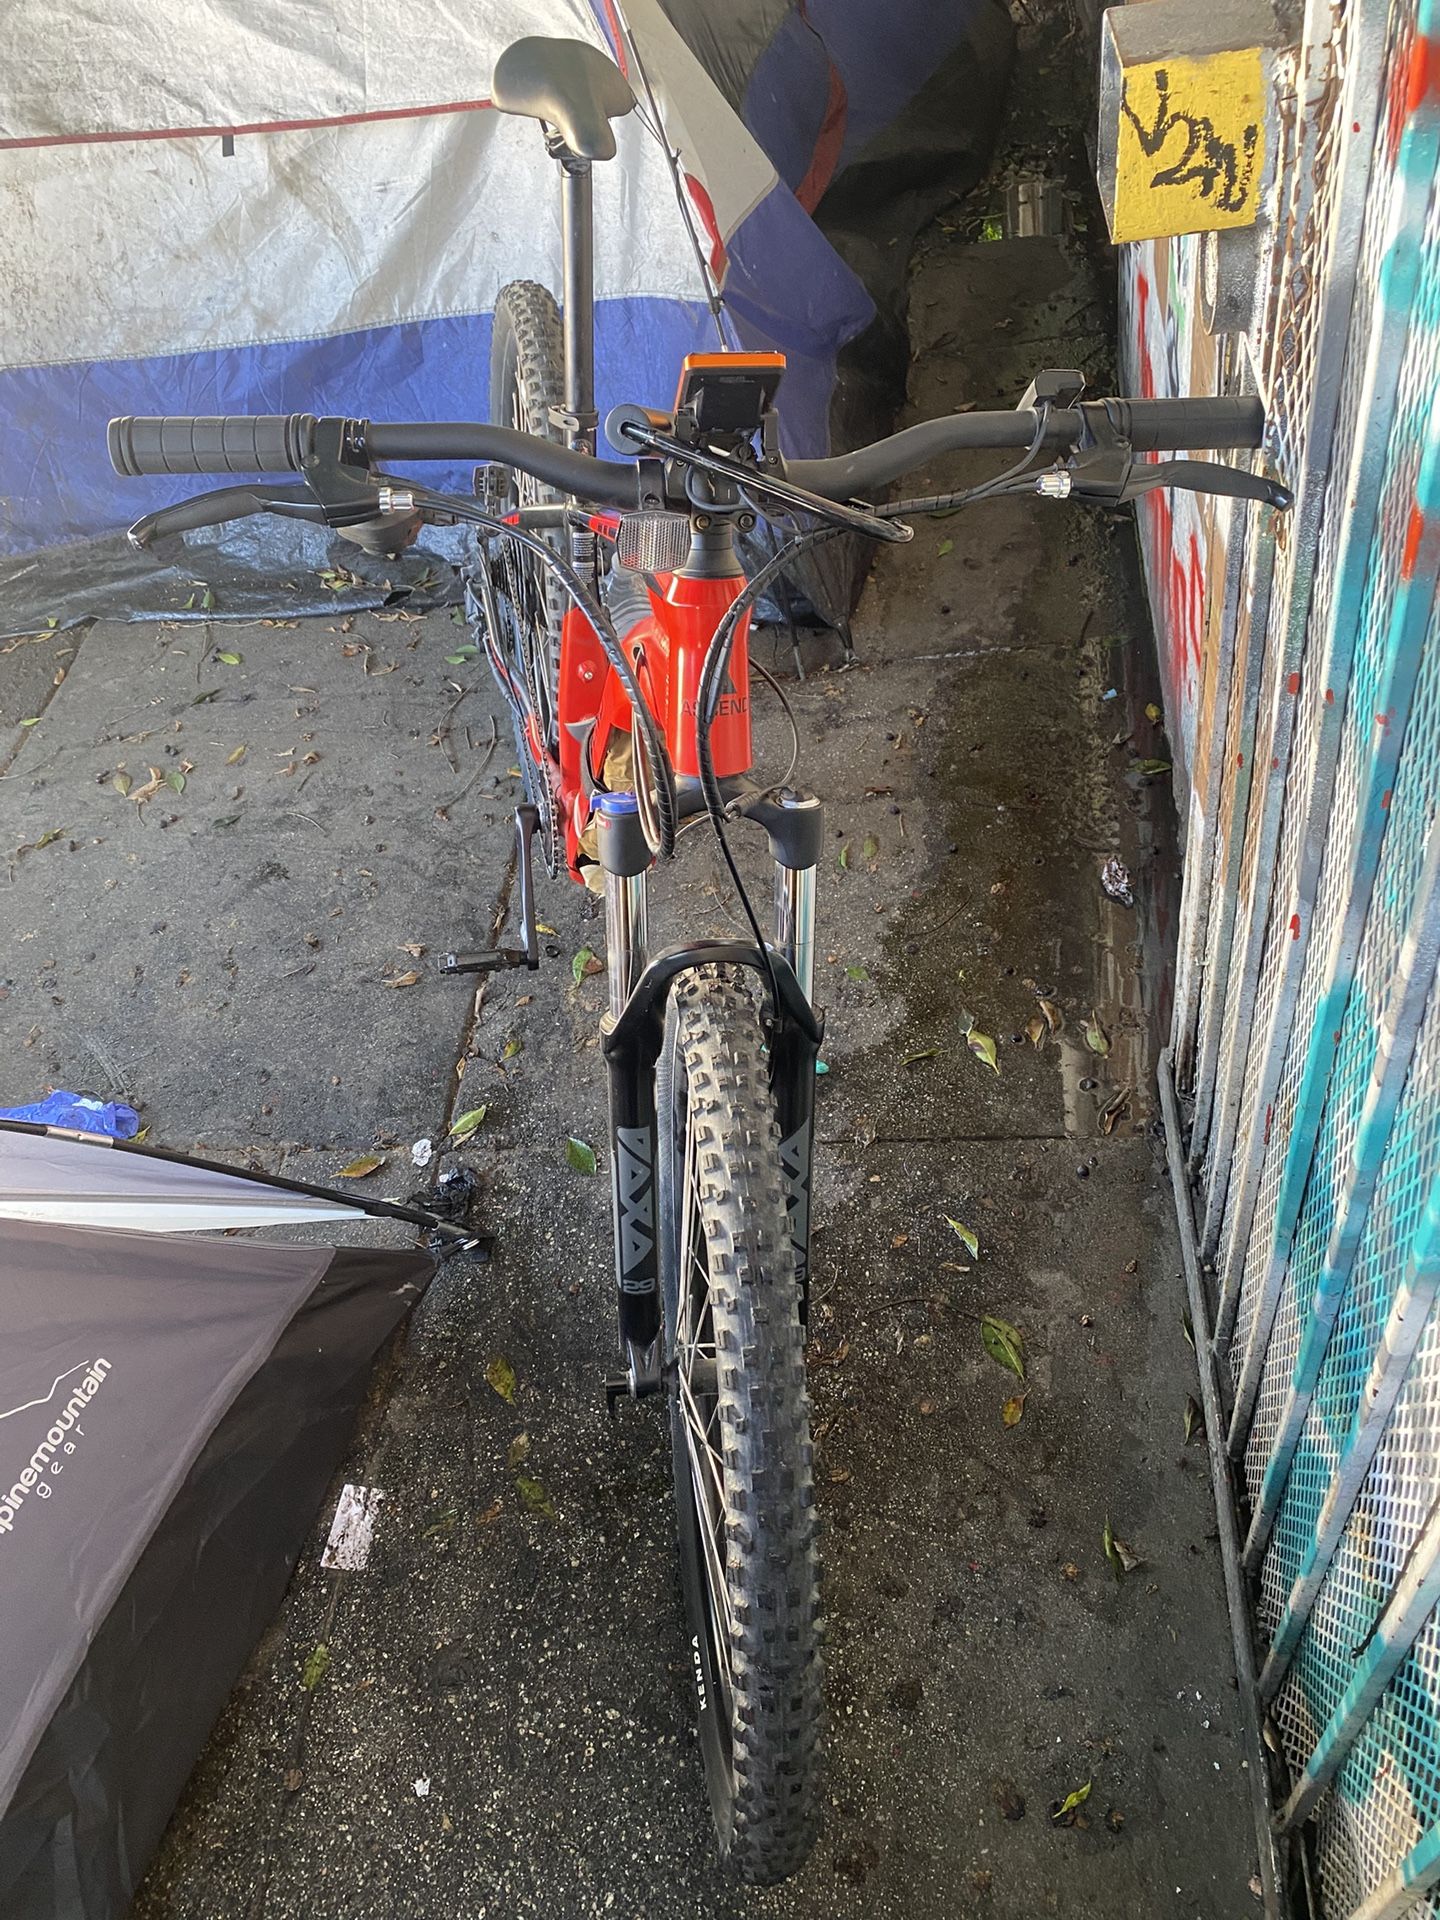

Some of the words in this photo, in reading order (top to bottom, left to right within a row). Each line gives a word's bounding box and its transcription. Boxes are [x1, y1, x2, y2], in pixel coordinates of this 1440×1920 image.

[681, 696, 748, 716] AEND
[622, 1277, 656, 1295] 29
[0, 1358, 112, 1534] pinemountain
[36, 1424, 85, 1499] gear
[691, 1634, 707, 1711] KENDA
